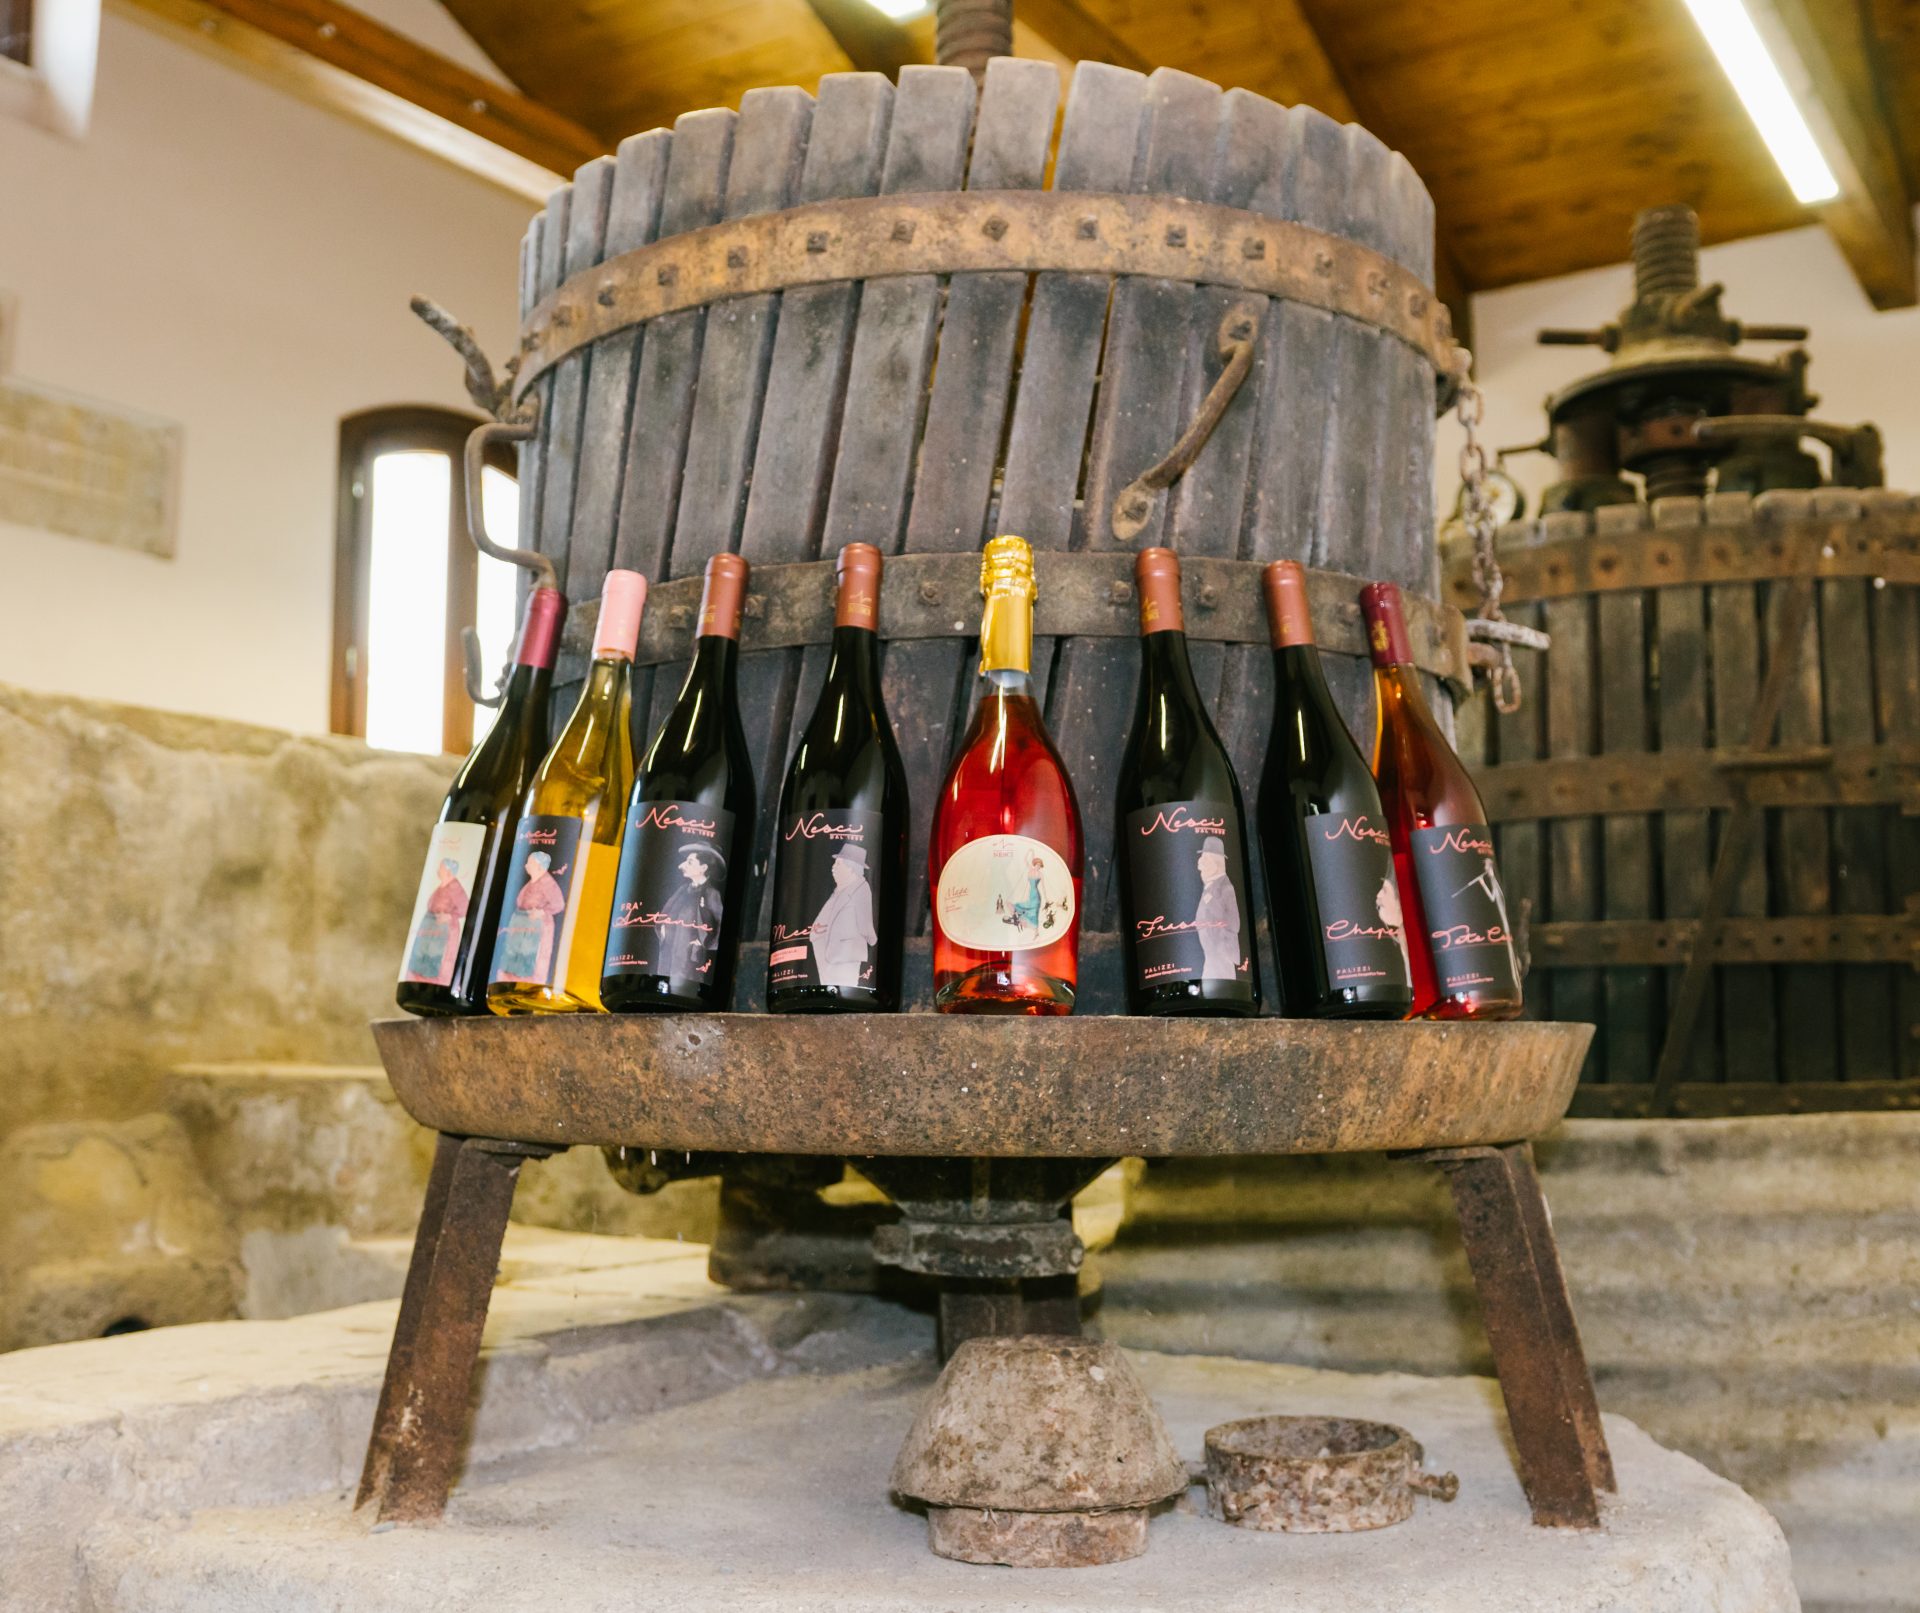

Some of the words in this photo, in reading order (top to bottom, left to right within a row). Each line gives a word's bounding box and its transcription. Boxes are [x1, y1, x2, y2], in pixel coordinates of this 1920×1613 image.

[785, 812, 864, 841] Nesci
[1140, 807, 1225, 835] Nesci
[1144, 962, 1175, 974] PALIZZI
[1336, 964, 1371, 976] PALIZZI
